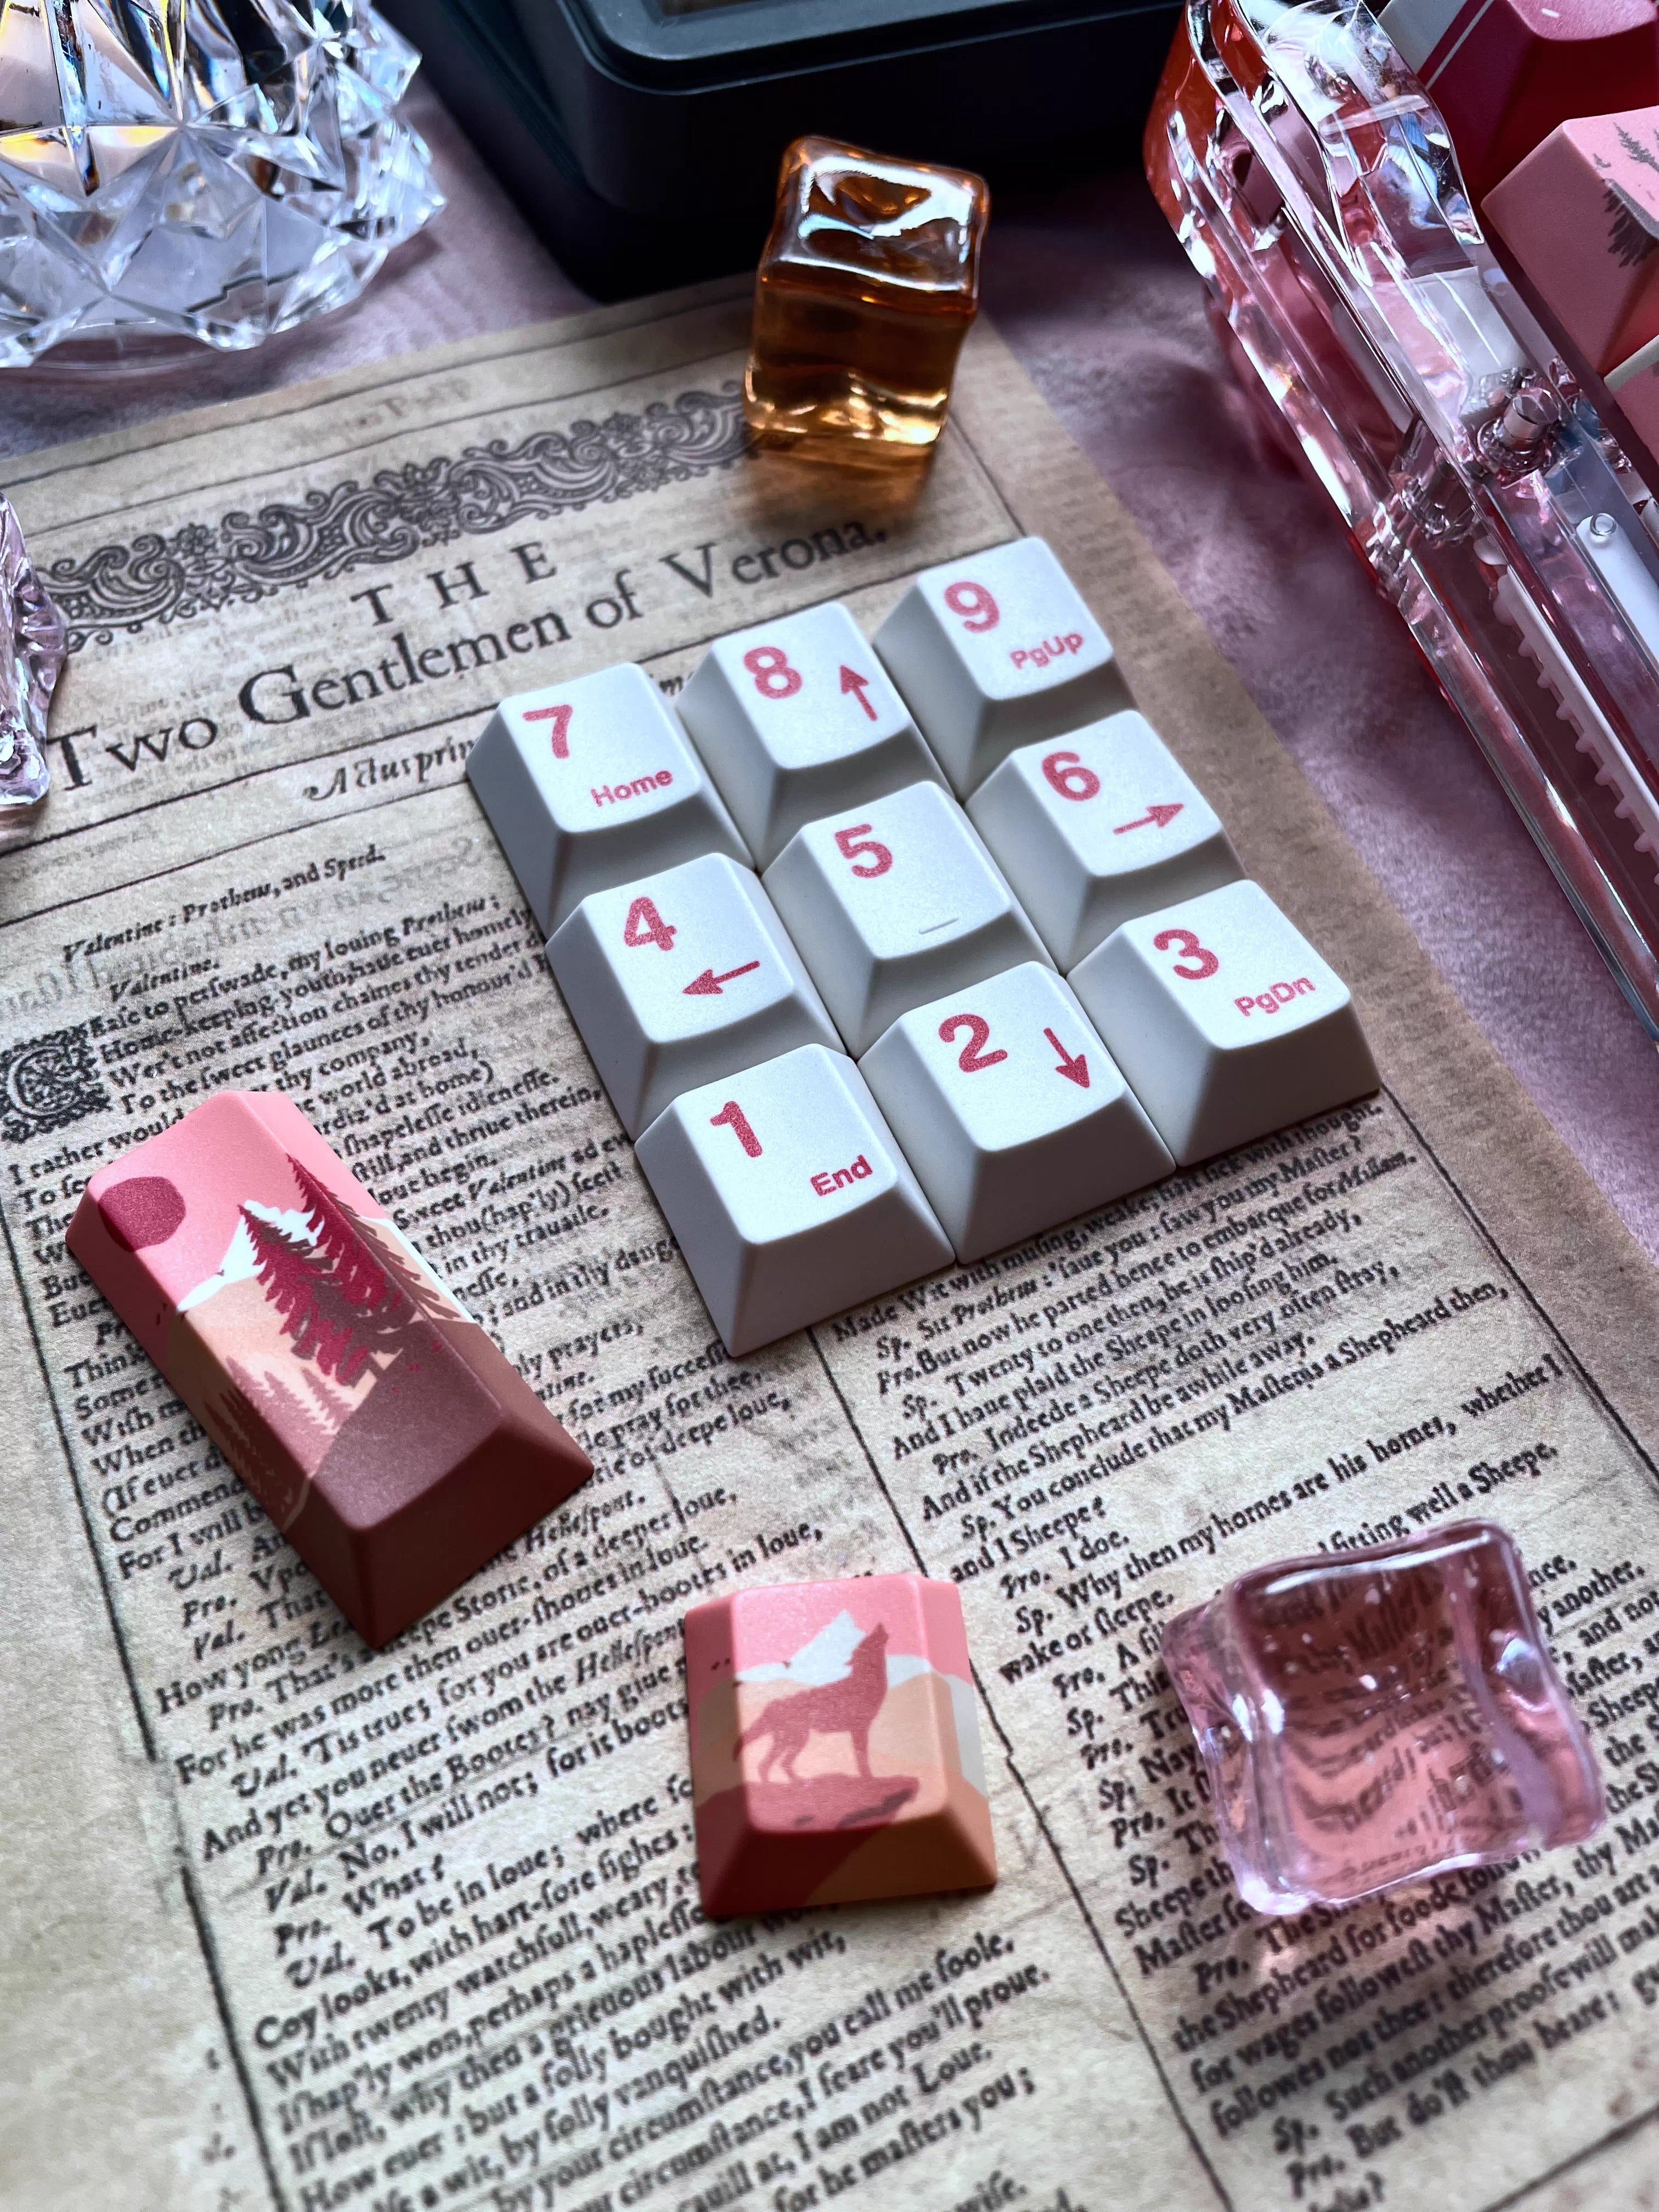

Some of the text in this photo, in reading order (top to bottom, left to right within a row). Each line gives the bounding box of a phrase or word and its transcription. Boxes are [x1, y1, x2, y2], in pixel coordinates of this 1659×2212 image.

[944, 582, 1000, 632] 9
[46, 520, 885, 792] Two Gentlemen of Verona.
[744, 646, 803, 699] 8
[1009, 632, 1083, 670] PgUp
[523, 704, 572, 759] 7
[591, 769, 673, 806] Home
[1041, 751, 1101, 802] 6
[834, 824, 893, 878] 5
[281, 862, 320, 890] and
[624, 897, 676, 951] 4
[1154, 929, 1219, 980] 3
[1234, 977, 1316, 1017] PgDn
[939, 1014, 1007, 1072] 2
[710, 1101, 763, 1158] 1
[810, 1155, 872, 1196] End
[91, 1432, 176, 1476] When
[893, 1419, 940, 1460] And
[922, 1478, 972, 1521] And
[990, 1488, 1048, 1521] You
[1048, 1441, 1148, 1498] conclude
[117, 1545, 163, 1580] For
[951, 1546, 995, 1583] and
[1014, 1605, 1053, 1637] Sp.
[1054, 1570, 1122, 1611] Why
[1124, 1544, 1178, 1581] then
[1177, 1525, 1216, 1555] my
[1293, 1472, 1329, 1499] are
[1327, 1453, 1367, 1482] his
[154, 1633, 308, 1715] How yong
[479, 1651, 531, 1697] you
[998, 1639, 1063, 1684] wake
[173, 1749, 226, 1786] For
[271, 1705, 326, 1741] was
[330, 1673, 398, 1716] more
[403, 1645, 461, 1682] then
[203, 1807, 262, 1862] And
[419, 1793, 474, 1837] will
[575, 1796, 658, 1846] where
[1555, 1894, 1614, 1939] thou
[253, 2006, 317, 2051] Coy
[843, 1988, 891, 2036] call
